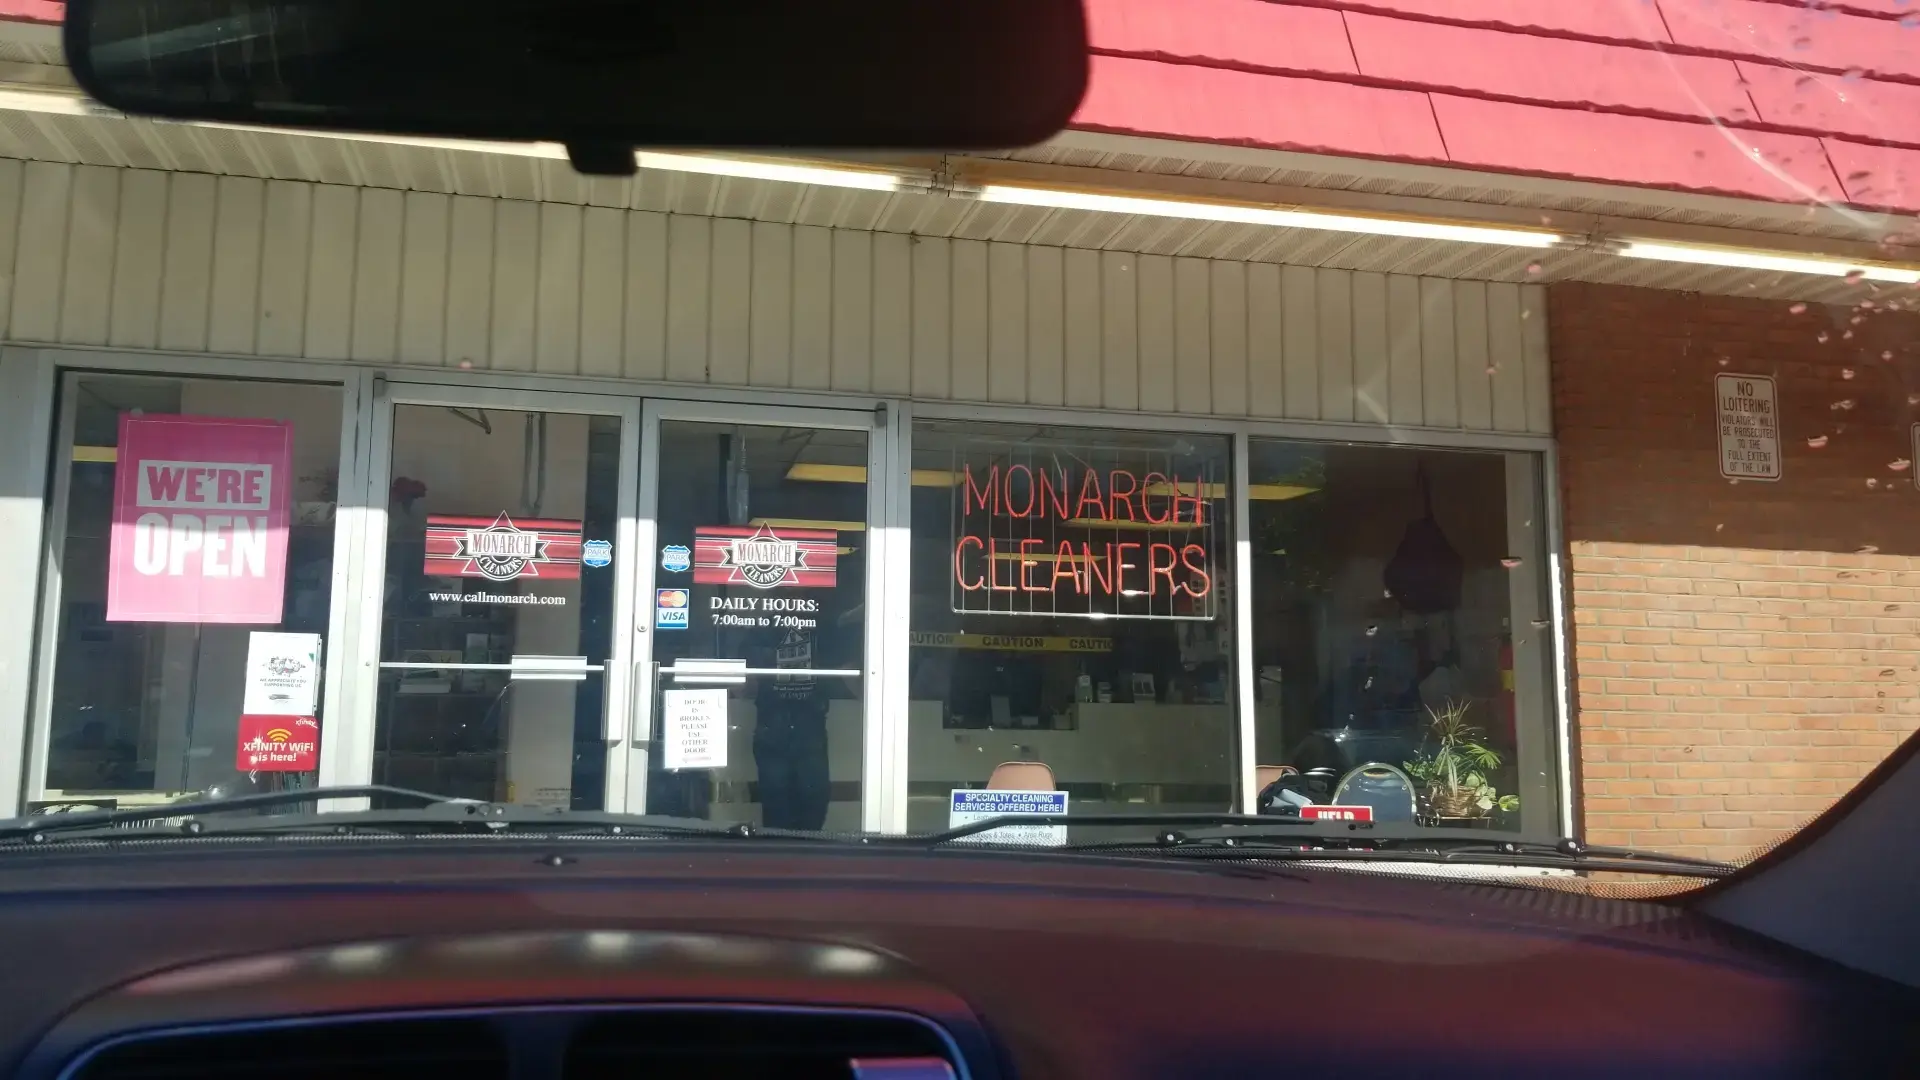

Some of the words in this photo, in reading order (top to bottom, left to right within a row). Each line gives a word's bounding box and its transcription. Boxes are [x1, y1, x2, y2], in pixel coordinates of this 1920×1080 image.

[1737, 381, 1753, 396] NO
[1723, 398, 1770, 414] LOITERING
[1721, 414, 1756, 426] VIOLATORS
[1759, 417, 1774, 427] WILL
[1722, 426, 1731, 436] BE
[1734, 427, 1774, 439] PROSECUTED
[1737, 438, 1746, 449] TO
[1749, 440, 1761, 450] THE
[1728, 450, 1744, 461] FULL
[1748, 451, 1771, 462] EXTENT
[1730, 461, 1738, 472] OF
[1742, 462, 1754, 473] THE
[1757, 464, 1771, 474] LAW
[146, 466, 264, 504] WE'RE
[964, 463, 1204, 526] MONARCH
[134, 512, 267, 577] OPEN
[472, 533, 532, 554] MONARCH
[737, 542, 792, 563] MONARCH
[479, 557, 523, 575] CLEANERS
[955, 535, 1211, 598] CLEANERS
[744, 565, 784, 583] CLEANERS
[429, 591, 566, 605] www.callmonarch.com
[711, 597, 758, 610] DAILY
[762, 598, 819, 612] HOURS:
[662, 611, 685, 620] VISA
[712, 614, 755, 626] 7:00am
[758, 615, 769, 626] to
[774, 615, 816, 629] 7:00pm
[909, 633, 952, 645] AUTION
[982, 636, 1044, 648] CAUTION
[243, 742, 286, 752] XFINITY
[289, 742, 314, 752] WiFi
[258, 752, 268, 761] is
[270, 752, 297, 762] here!
[965, 793, 1010, 802] SPECIALTY
[1012, 794, 1054, 803] CLEANING
[955, 802, 995, 811] SERVICES
[998, 803, 1036, 812] OFFERED
[1037, 804, 1063, 812] HERE!
